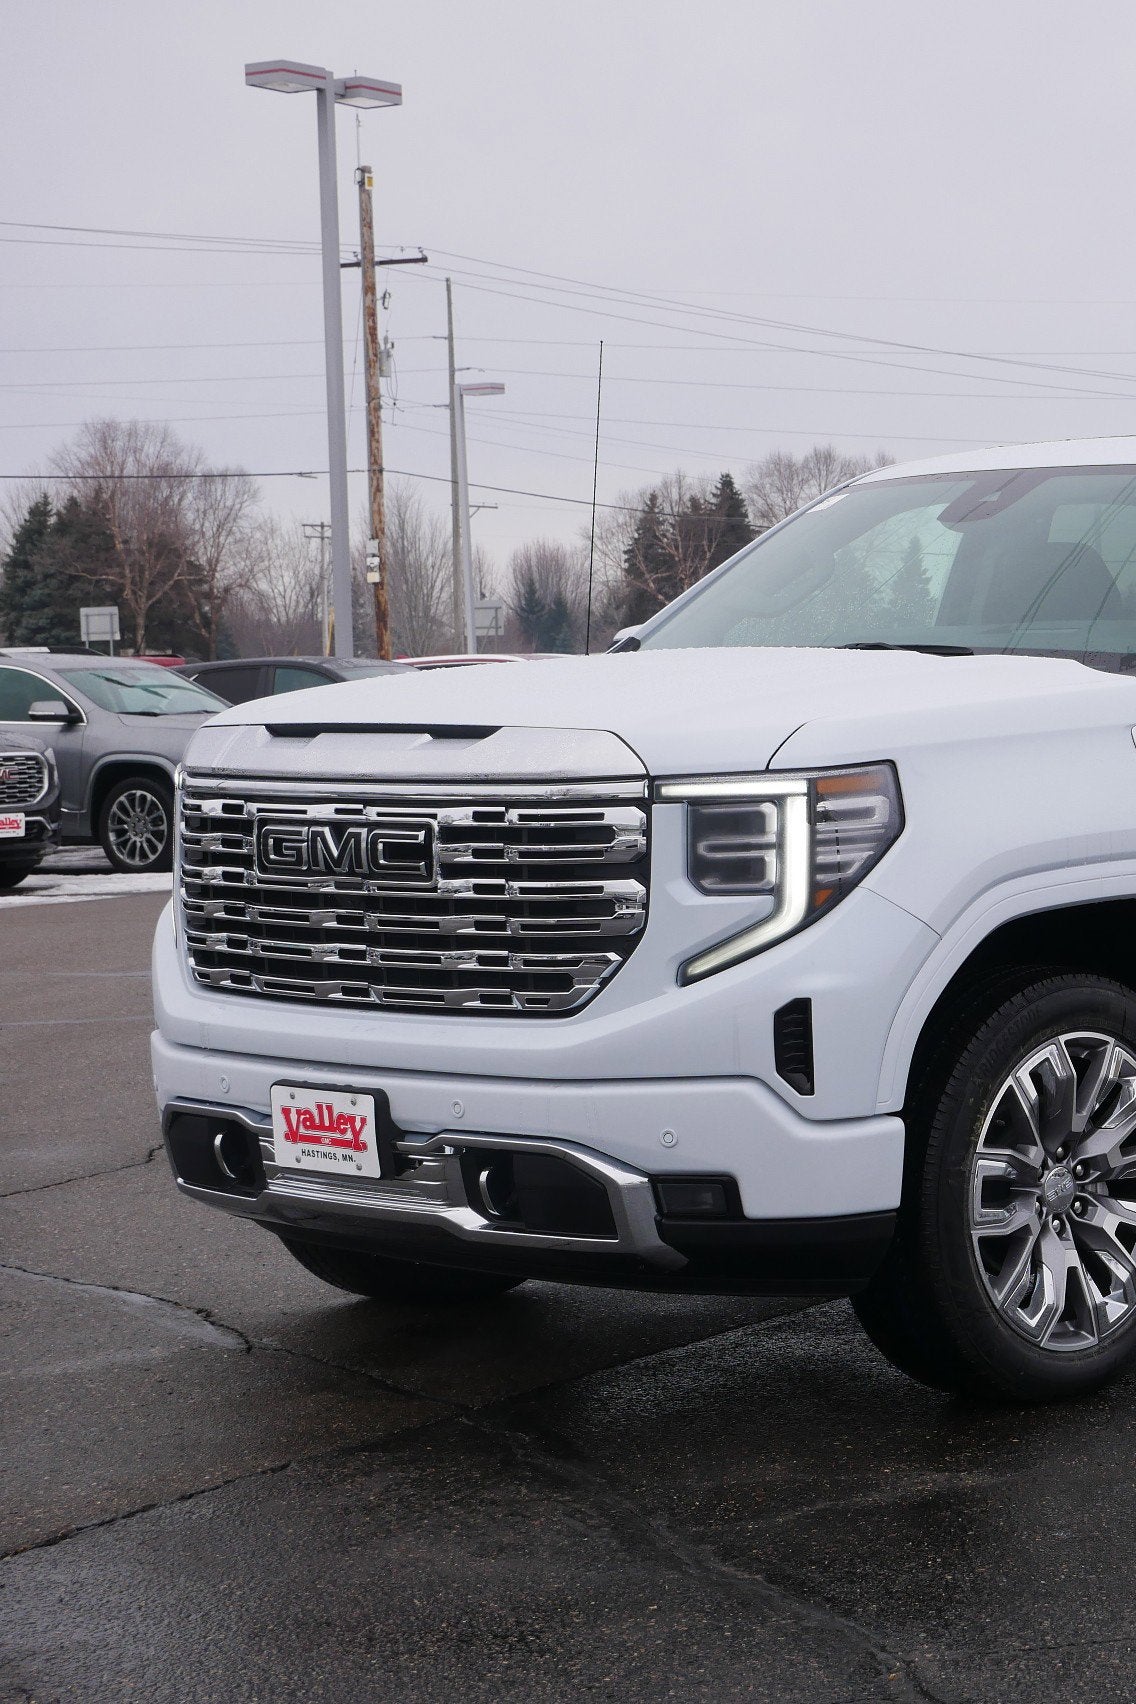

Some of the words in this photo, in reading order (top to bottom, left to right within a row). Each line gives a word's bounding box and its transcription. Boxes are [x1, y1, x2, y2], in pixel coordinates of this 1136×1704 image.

[260, 825, 427, 876] GMC
[281, 1101, 367, 1152] Valley
[301, 1148, 340, 1162] HASTINGS,
[341, 1154, 356, 1163] MN.
